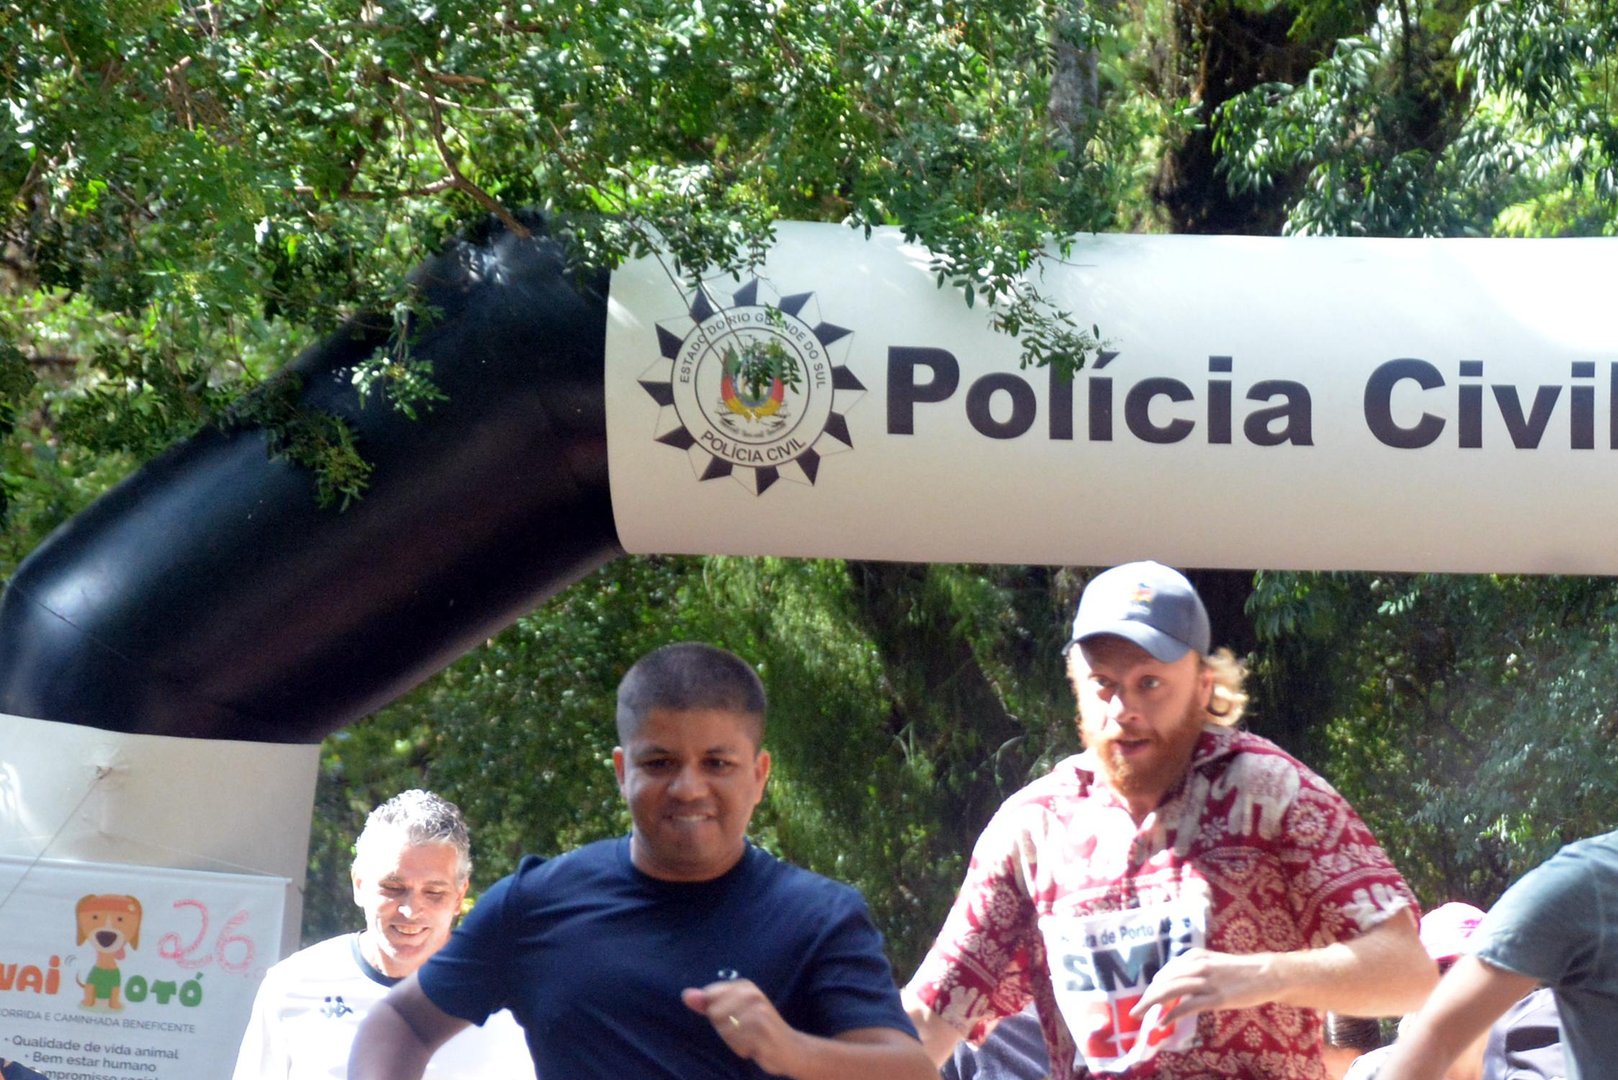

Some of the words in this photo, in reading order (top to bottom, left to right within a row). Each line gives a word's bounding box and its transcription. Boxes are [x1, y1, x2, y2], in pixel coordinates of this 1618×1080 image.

[680, 334, 707, 384] ESTADO
[706, 320, 727, 336] DO
[728, 312, 751, 326] RIO
[755, 312, 805, 340] GRNDE
[803, 341, 819, 360] DO
[813, 363, 827, 389] SUL
[886, 346, 1313, 447] Polícia
[700, 430, 764, 462] POLÍCIA
[767, 437, 806, 460] CIVIL
[1101, 932, 1116, 945] de
[1119, 925, 1154, 940] Porto
[46, 1013, 51, 1021] E
[53, 1013, 120, 1027] CAMINHADA
[123, 1019, 196, 1034] BENEFICENTE
[12, 1035, 81, 1052] Qualidade
[84, 1040, 101, 1053] de
[104, 1043, 131, 1056] vida
[134, 1046, 179, 1060] animal
[33, 1052, 63, 1064] Bem
[66, 1055, 99, 1067] estar
[102, 1056, 156, 1072] humano
